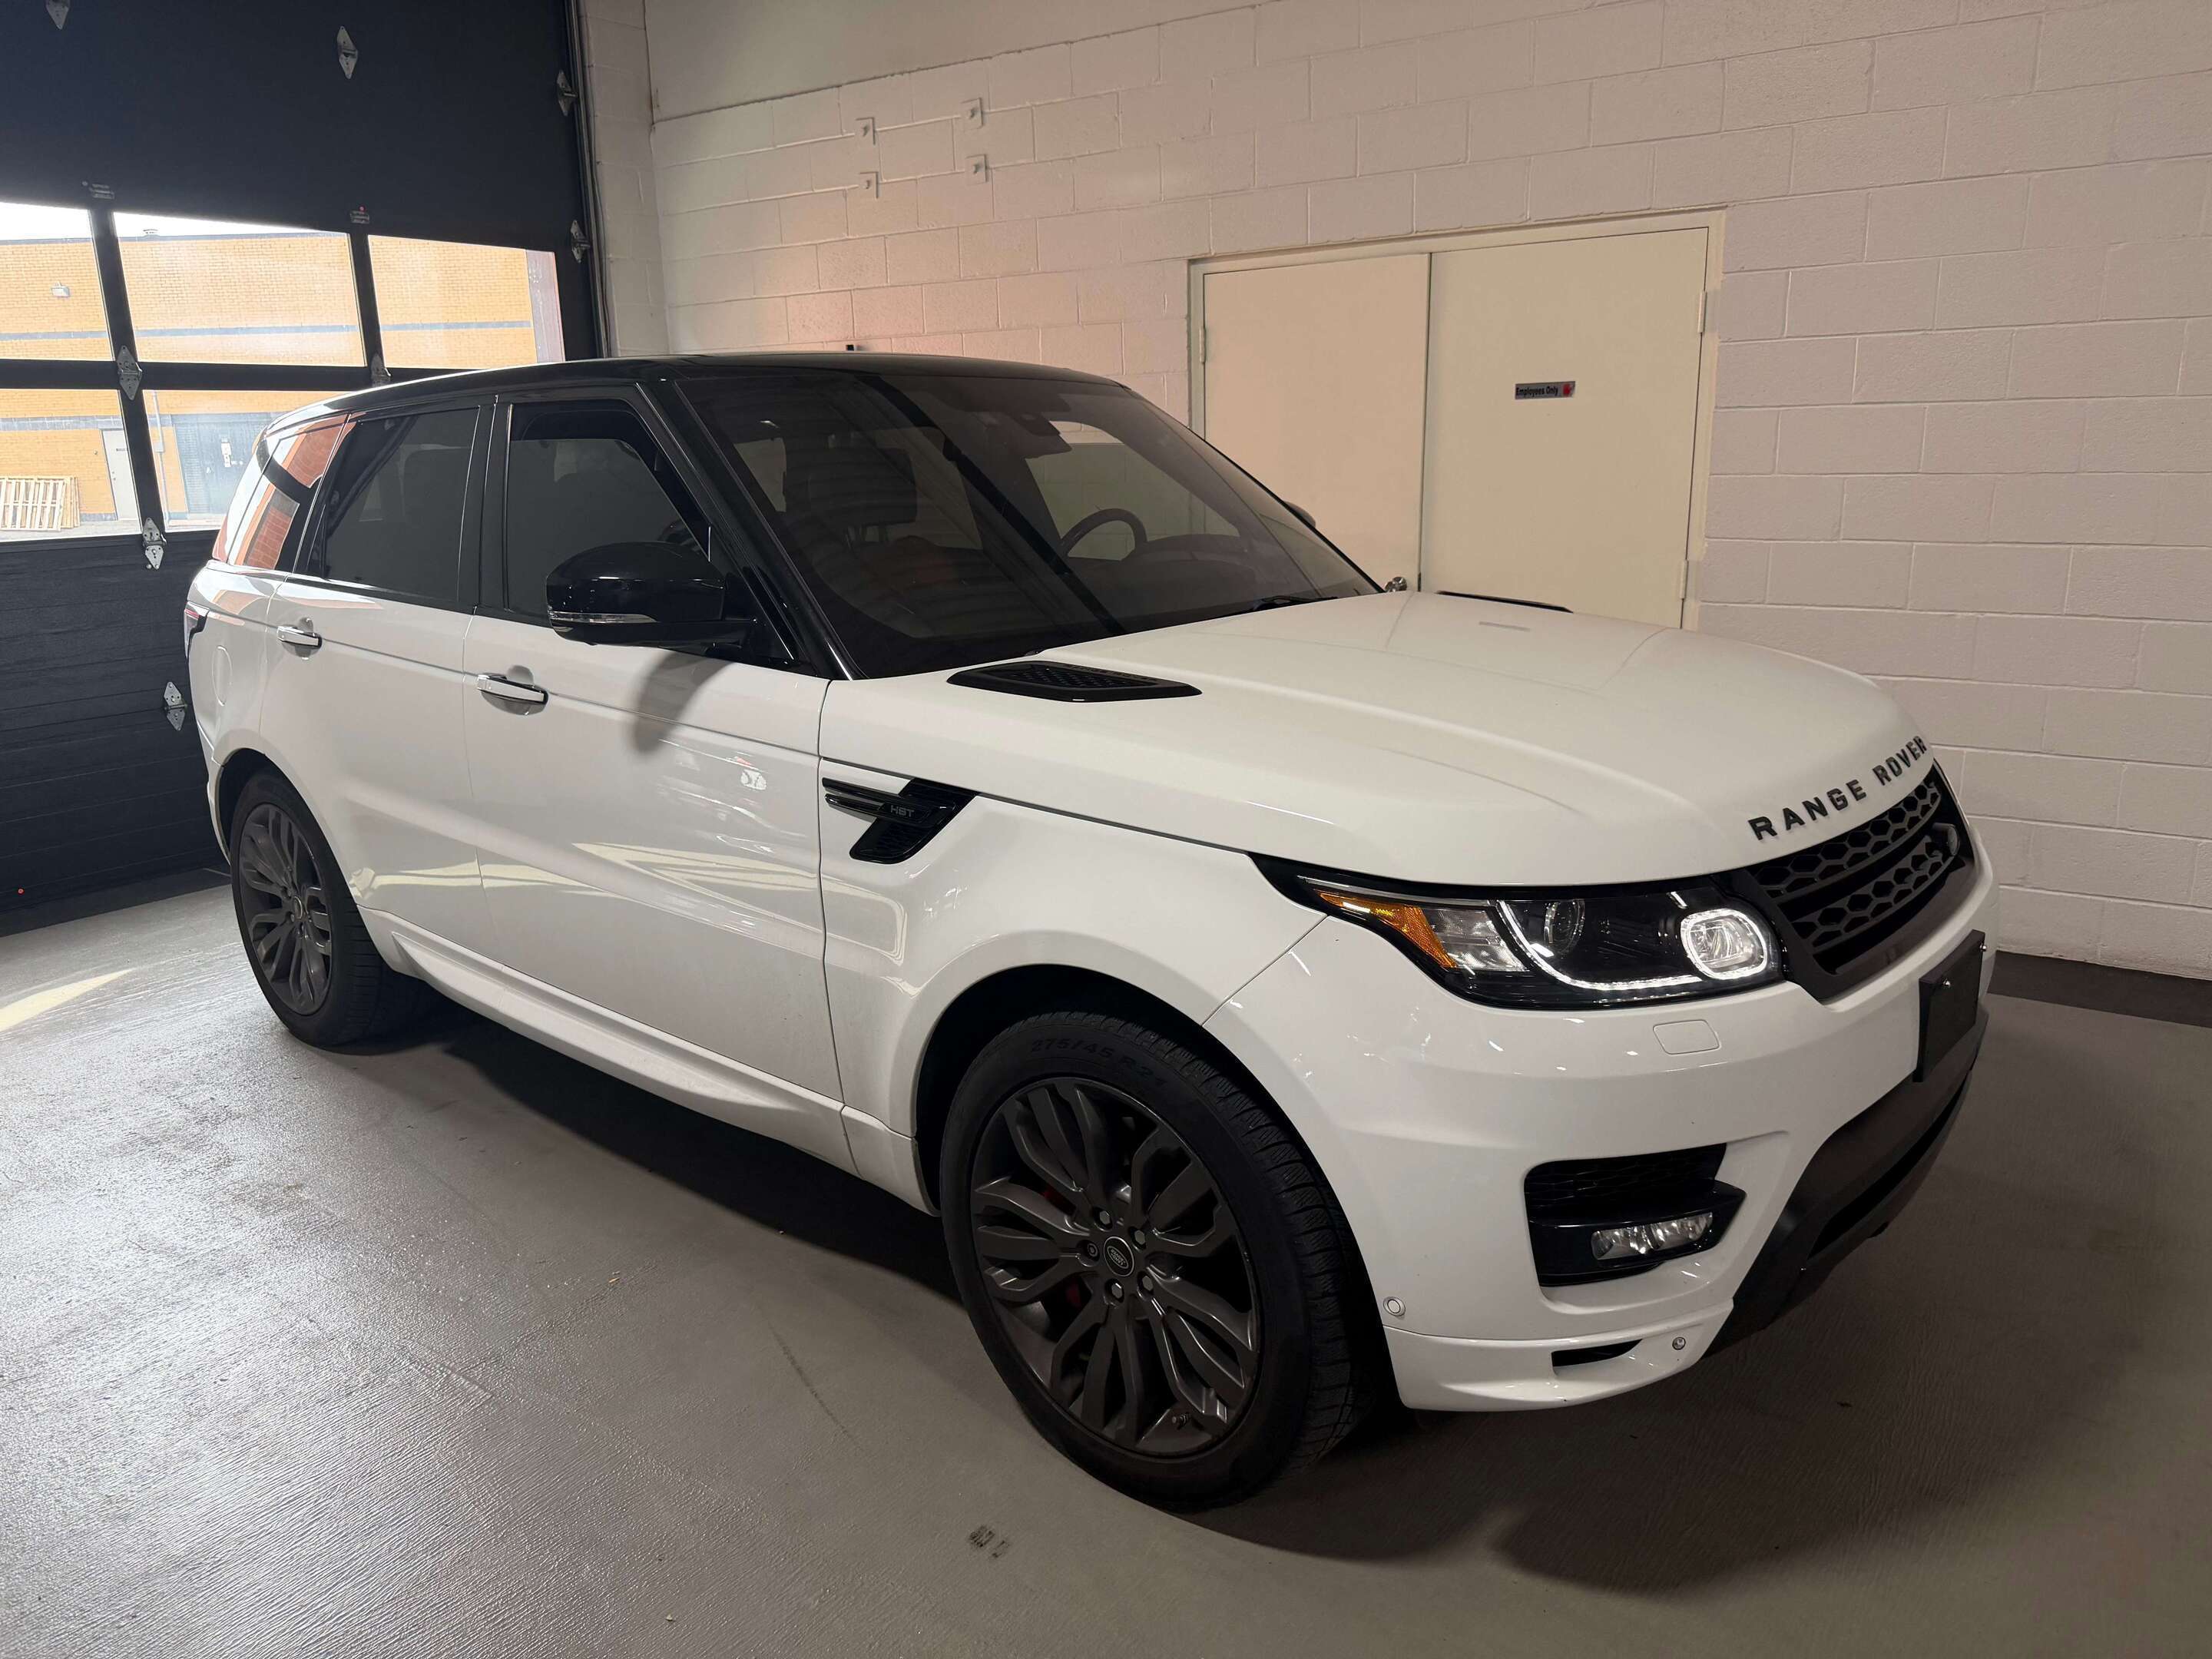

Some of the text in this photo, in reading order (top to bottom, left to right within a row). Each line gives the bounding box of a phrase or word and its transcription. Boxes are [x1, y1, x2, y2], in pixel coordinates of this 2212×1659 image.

[1515, 386, 1558, 397] Employees Only
[1747, 735, 1928, 840] RANGE ROVER
[1031, 1038, 1115, 1058] 275/45
